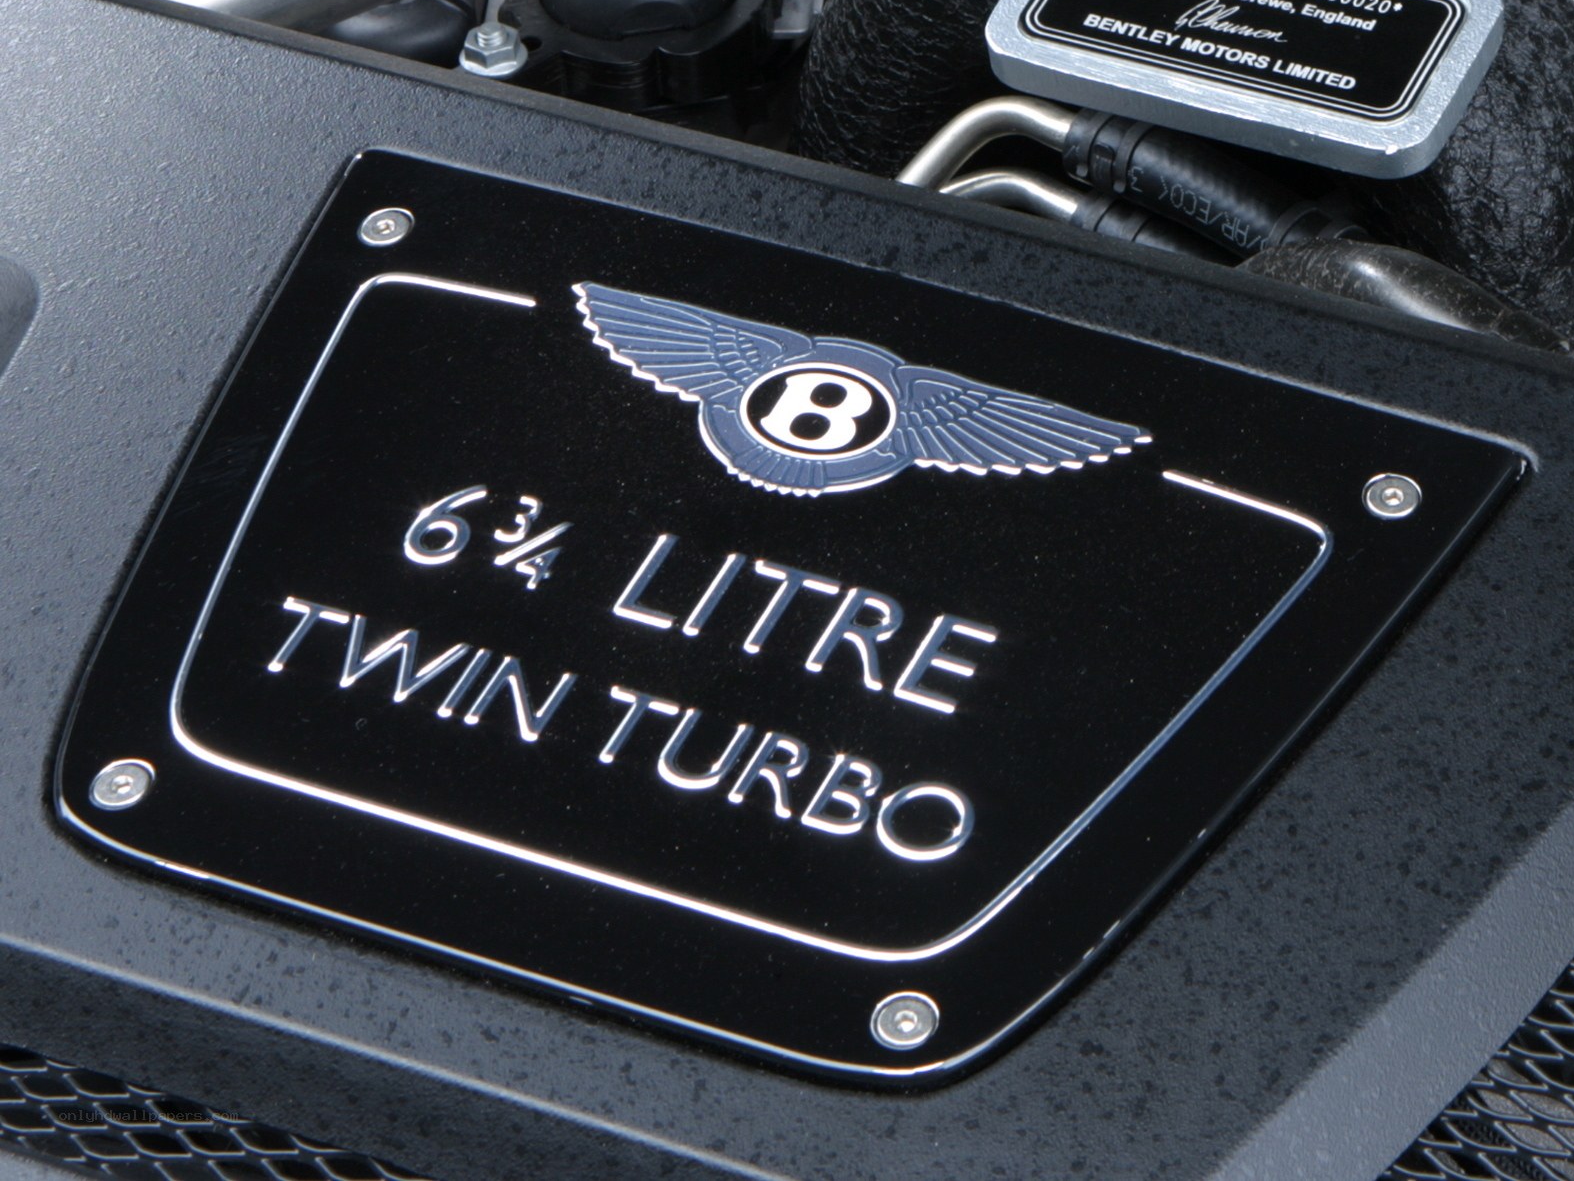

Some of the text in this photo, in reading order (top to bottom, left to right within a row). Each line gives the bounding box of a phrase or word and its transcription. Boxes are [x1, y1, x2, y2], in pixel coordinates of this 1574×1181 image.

[1083, 14, 1180, 46] BENTLEY
[1180, 36, 1270, 69] MOTORS
[1273, 60, 1356, 90] LIMITED
[1301, 4, 1376, 31] England
[758, 369, 873, 452] B
[611, 533, 999, 715] LITRE
[266, 595, 974, 864] TWIN TURBO
